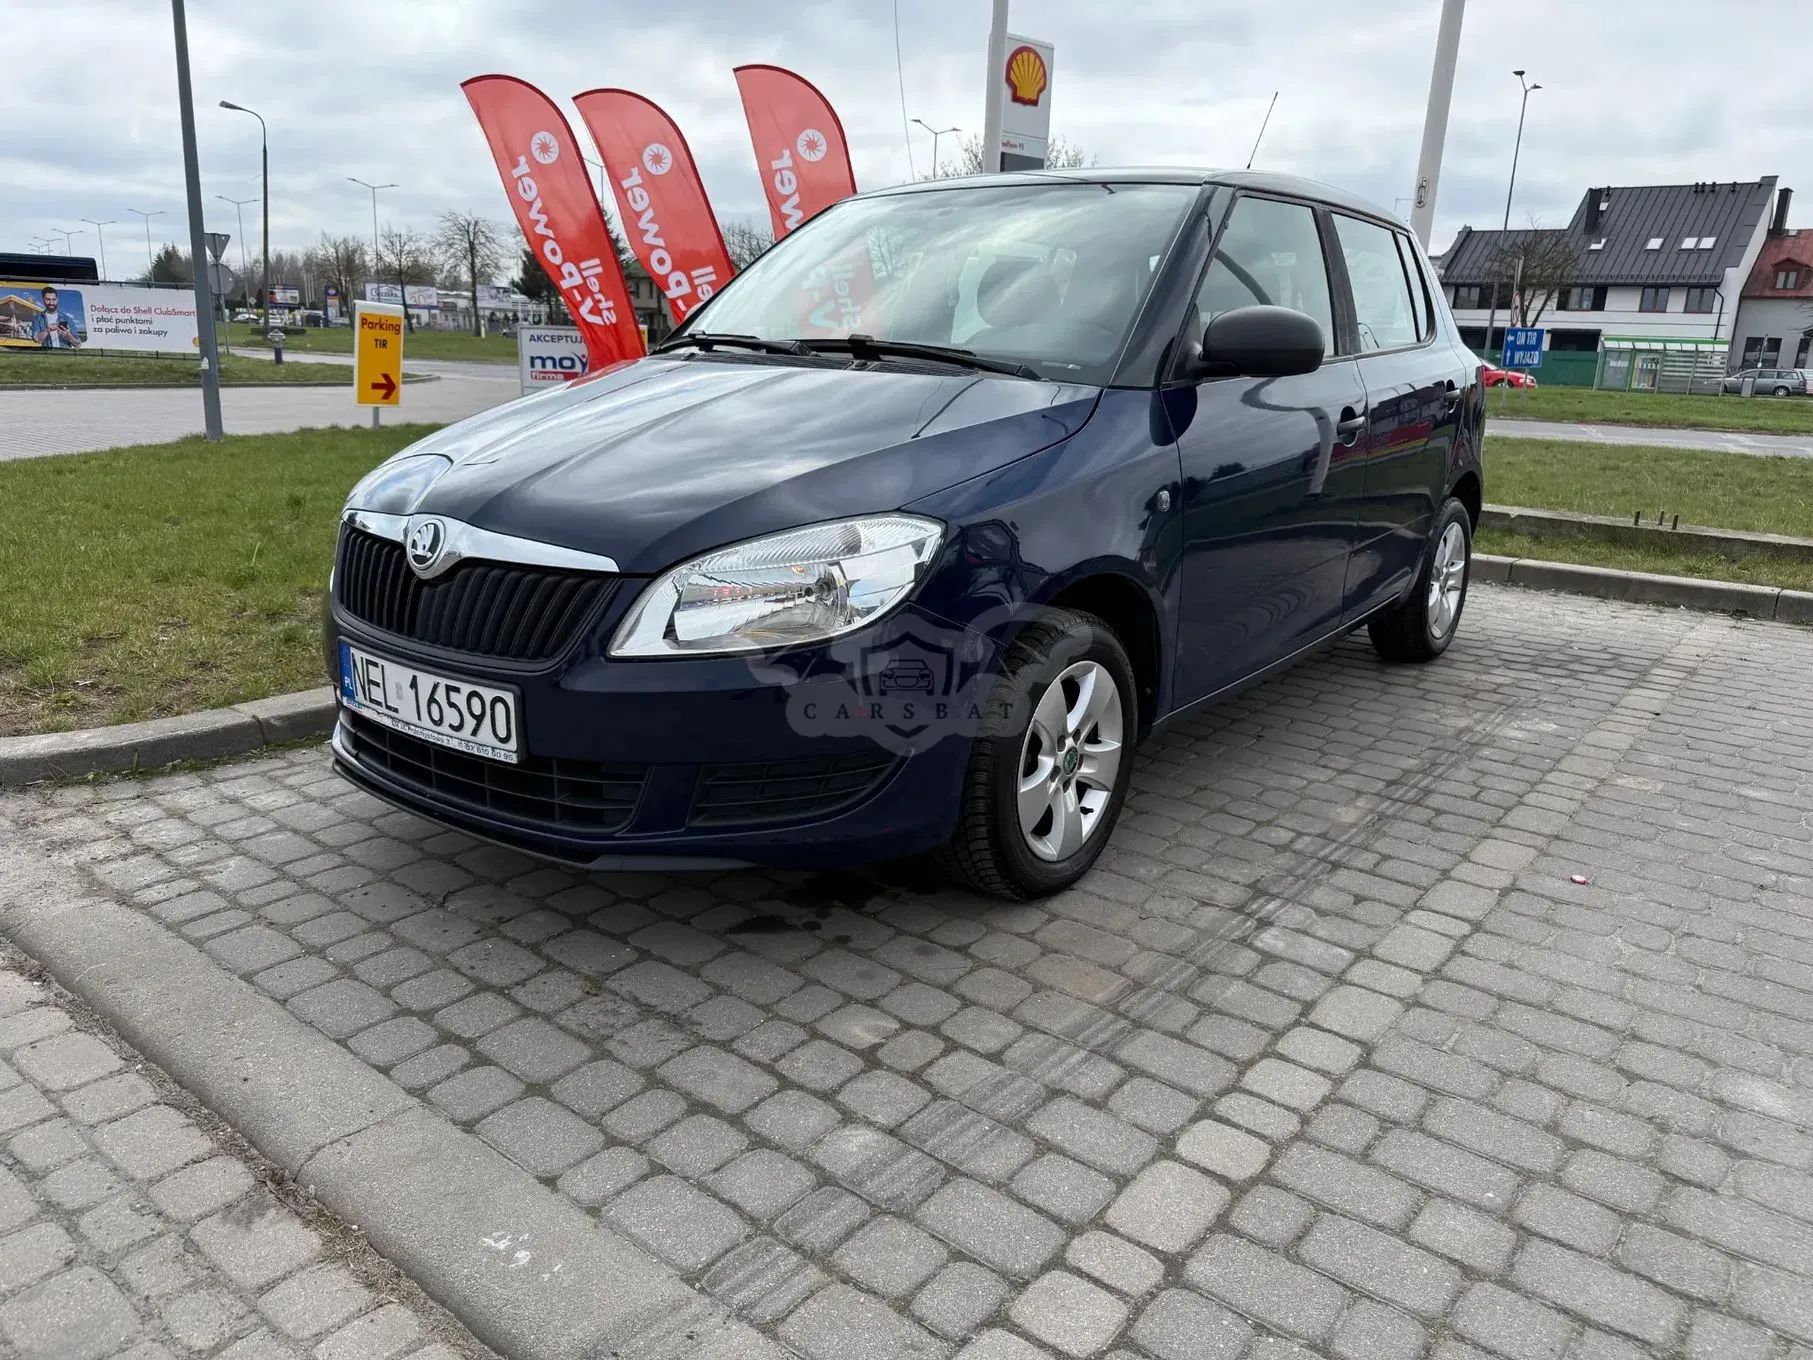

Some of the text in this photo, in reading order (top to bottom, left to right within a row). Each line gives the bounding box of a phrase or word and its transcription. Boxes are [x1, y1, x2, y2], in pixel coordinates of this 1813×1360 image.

[90, 304, 196, 317] Dołącz do Shell ClubSmart
[96, 315, 114, 325] płać
[115, 316, 153, 325] punktami
[361, 317, 401, 335] Parking
[105, 326, 133, 335] paliwo
[139, 327, 168, 338] zakupy
[1516, 331, 1537, 345] ON TIR
[374, 338, 388, 349] TIR
[1514, 350, 1539, 364] WYJAZD
[344, 676, 353, 690] PL
[351, 652, 512, 744] NEL 16590
